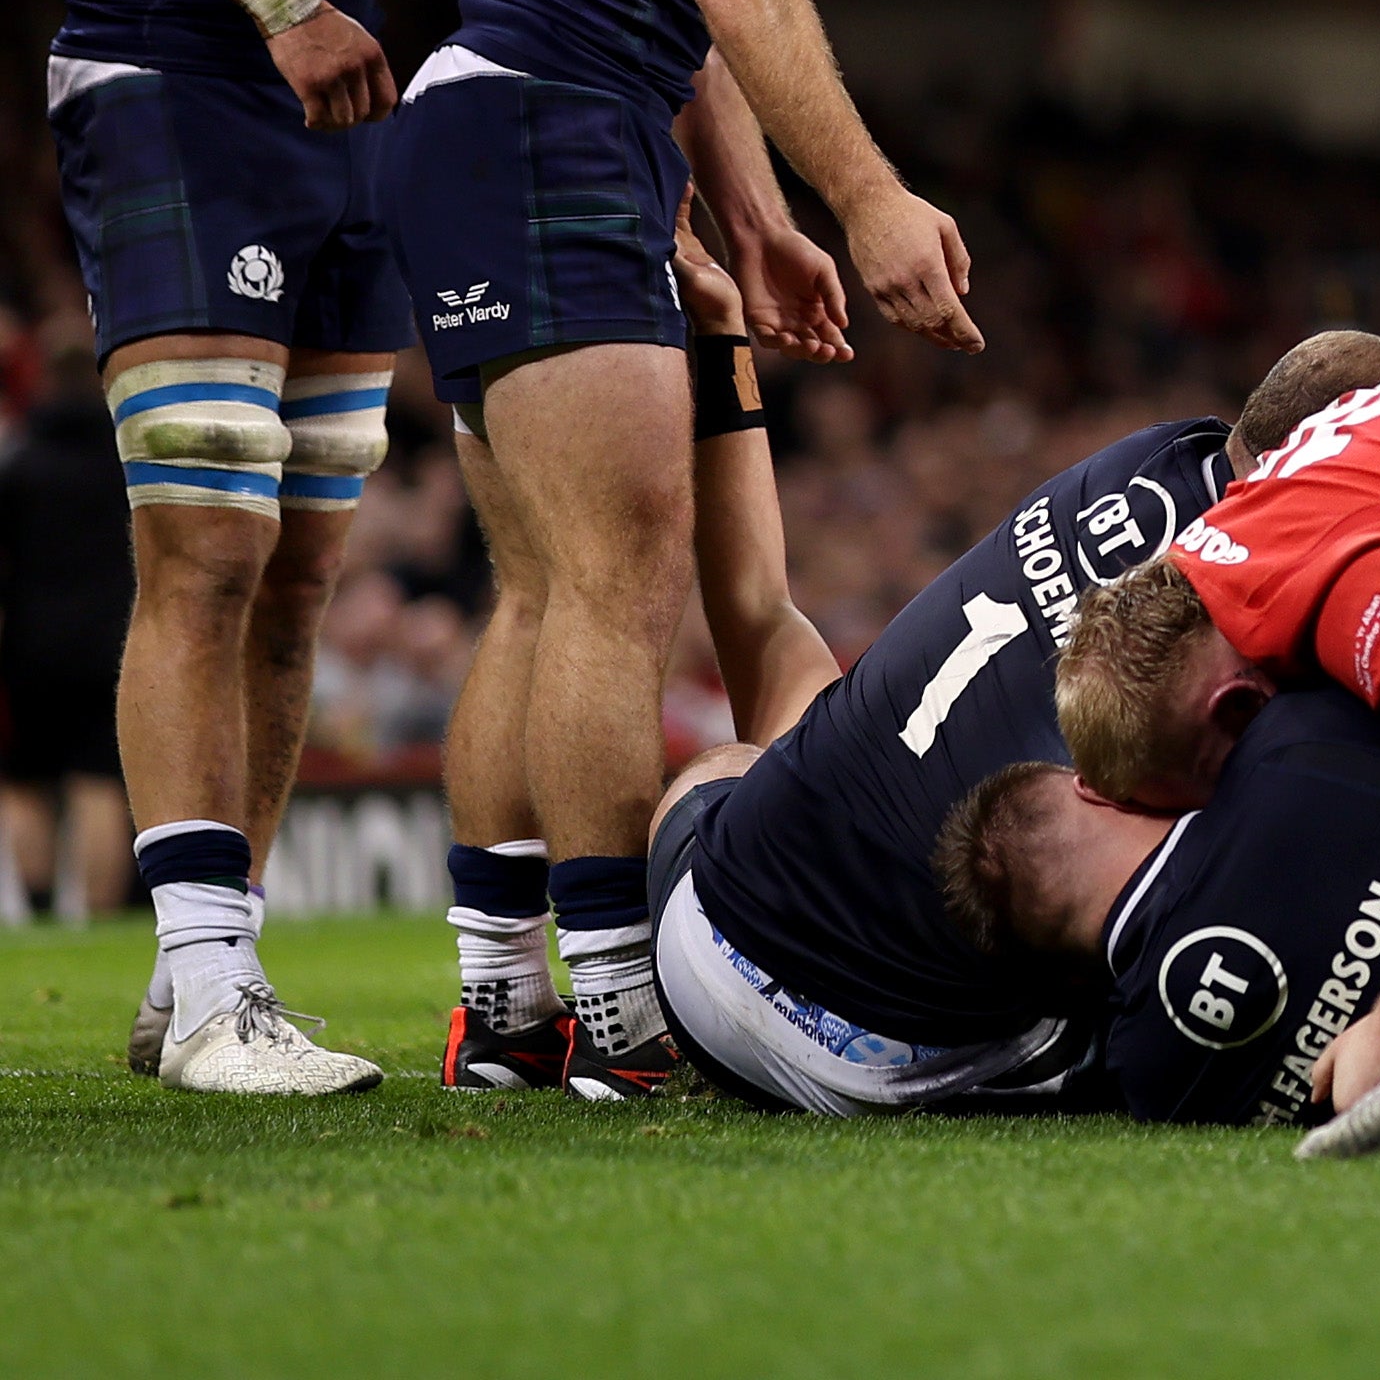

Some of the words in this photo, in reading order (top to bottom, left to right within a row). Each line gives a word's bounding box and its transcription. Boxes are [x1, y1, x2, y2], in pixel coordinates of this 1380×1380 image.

[432, 312, 465, 332] Peter
[465, 300, 510, 324] Vardy
[1087, 496, 1146, 557] BT
[898, 592, 1030, 760] 1
[1187, 951, 1250, 1032] BT
